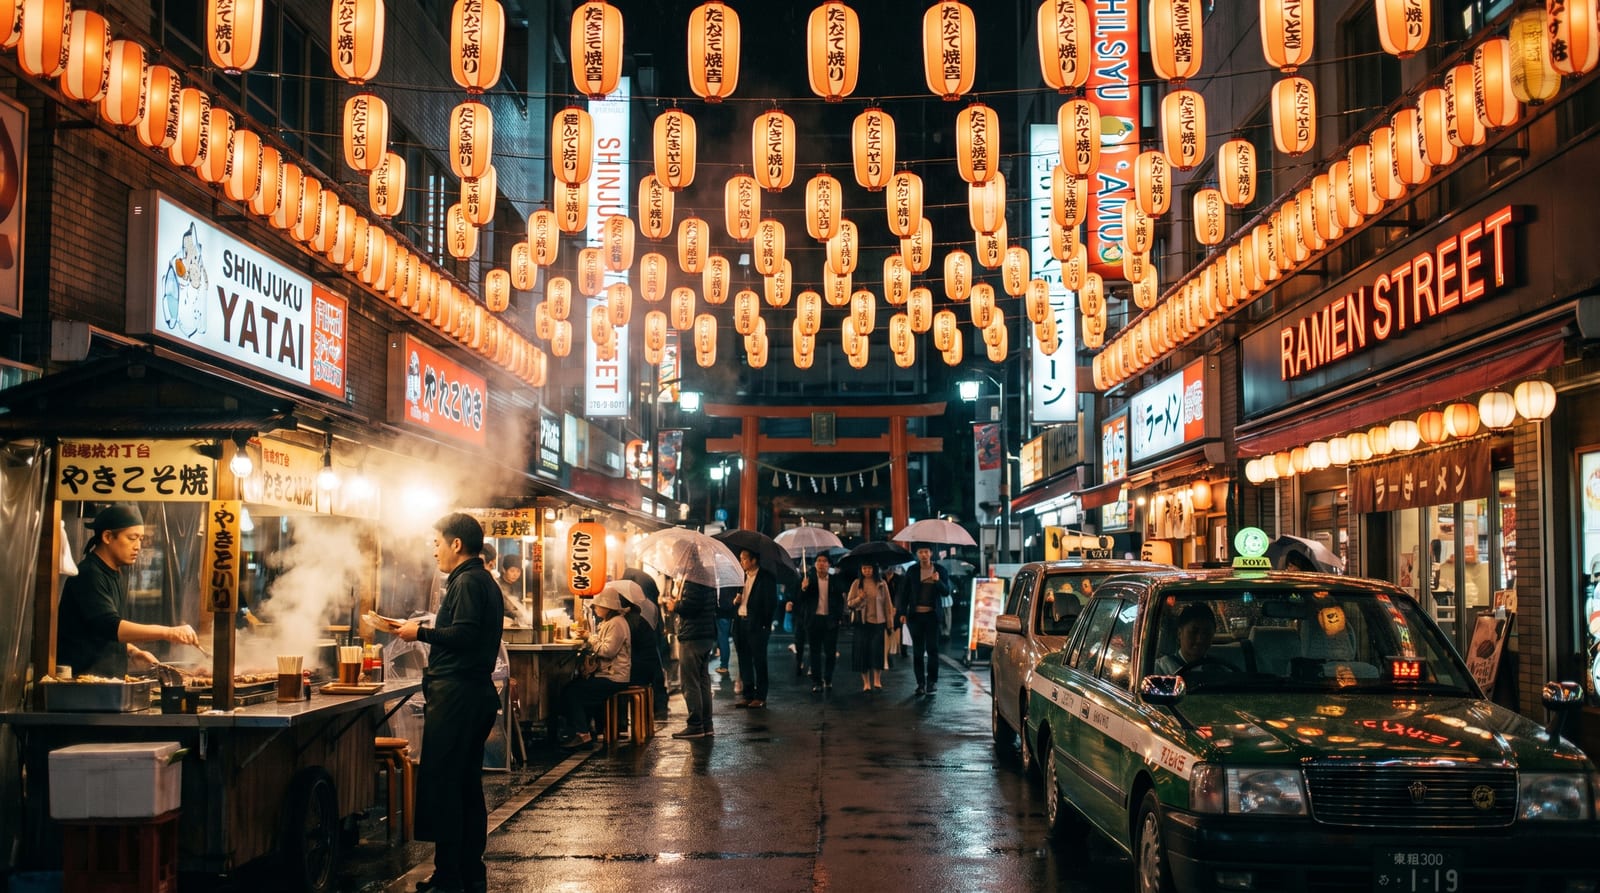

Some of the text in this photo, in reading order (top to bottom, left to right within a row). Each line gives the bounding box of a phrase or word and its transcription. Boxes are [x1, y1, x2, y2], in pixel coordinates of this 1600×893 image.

[223, 249, 303, 312] SHINJUKU
[1281, 205, 1513, 381] RAMEN STREET
[217, 286, 304, 370] YATAI
[1146, 393, 1182, 442] ラーメン
[61, 464, 209, 496] やきこそ焼
[572, 532, 591, 590] たこやき
